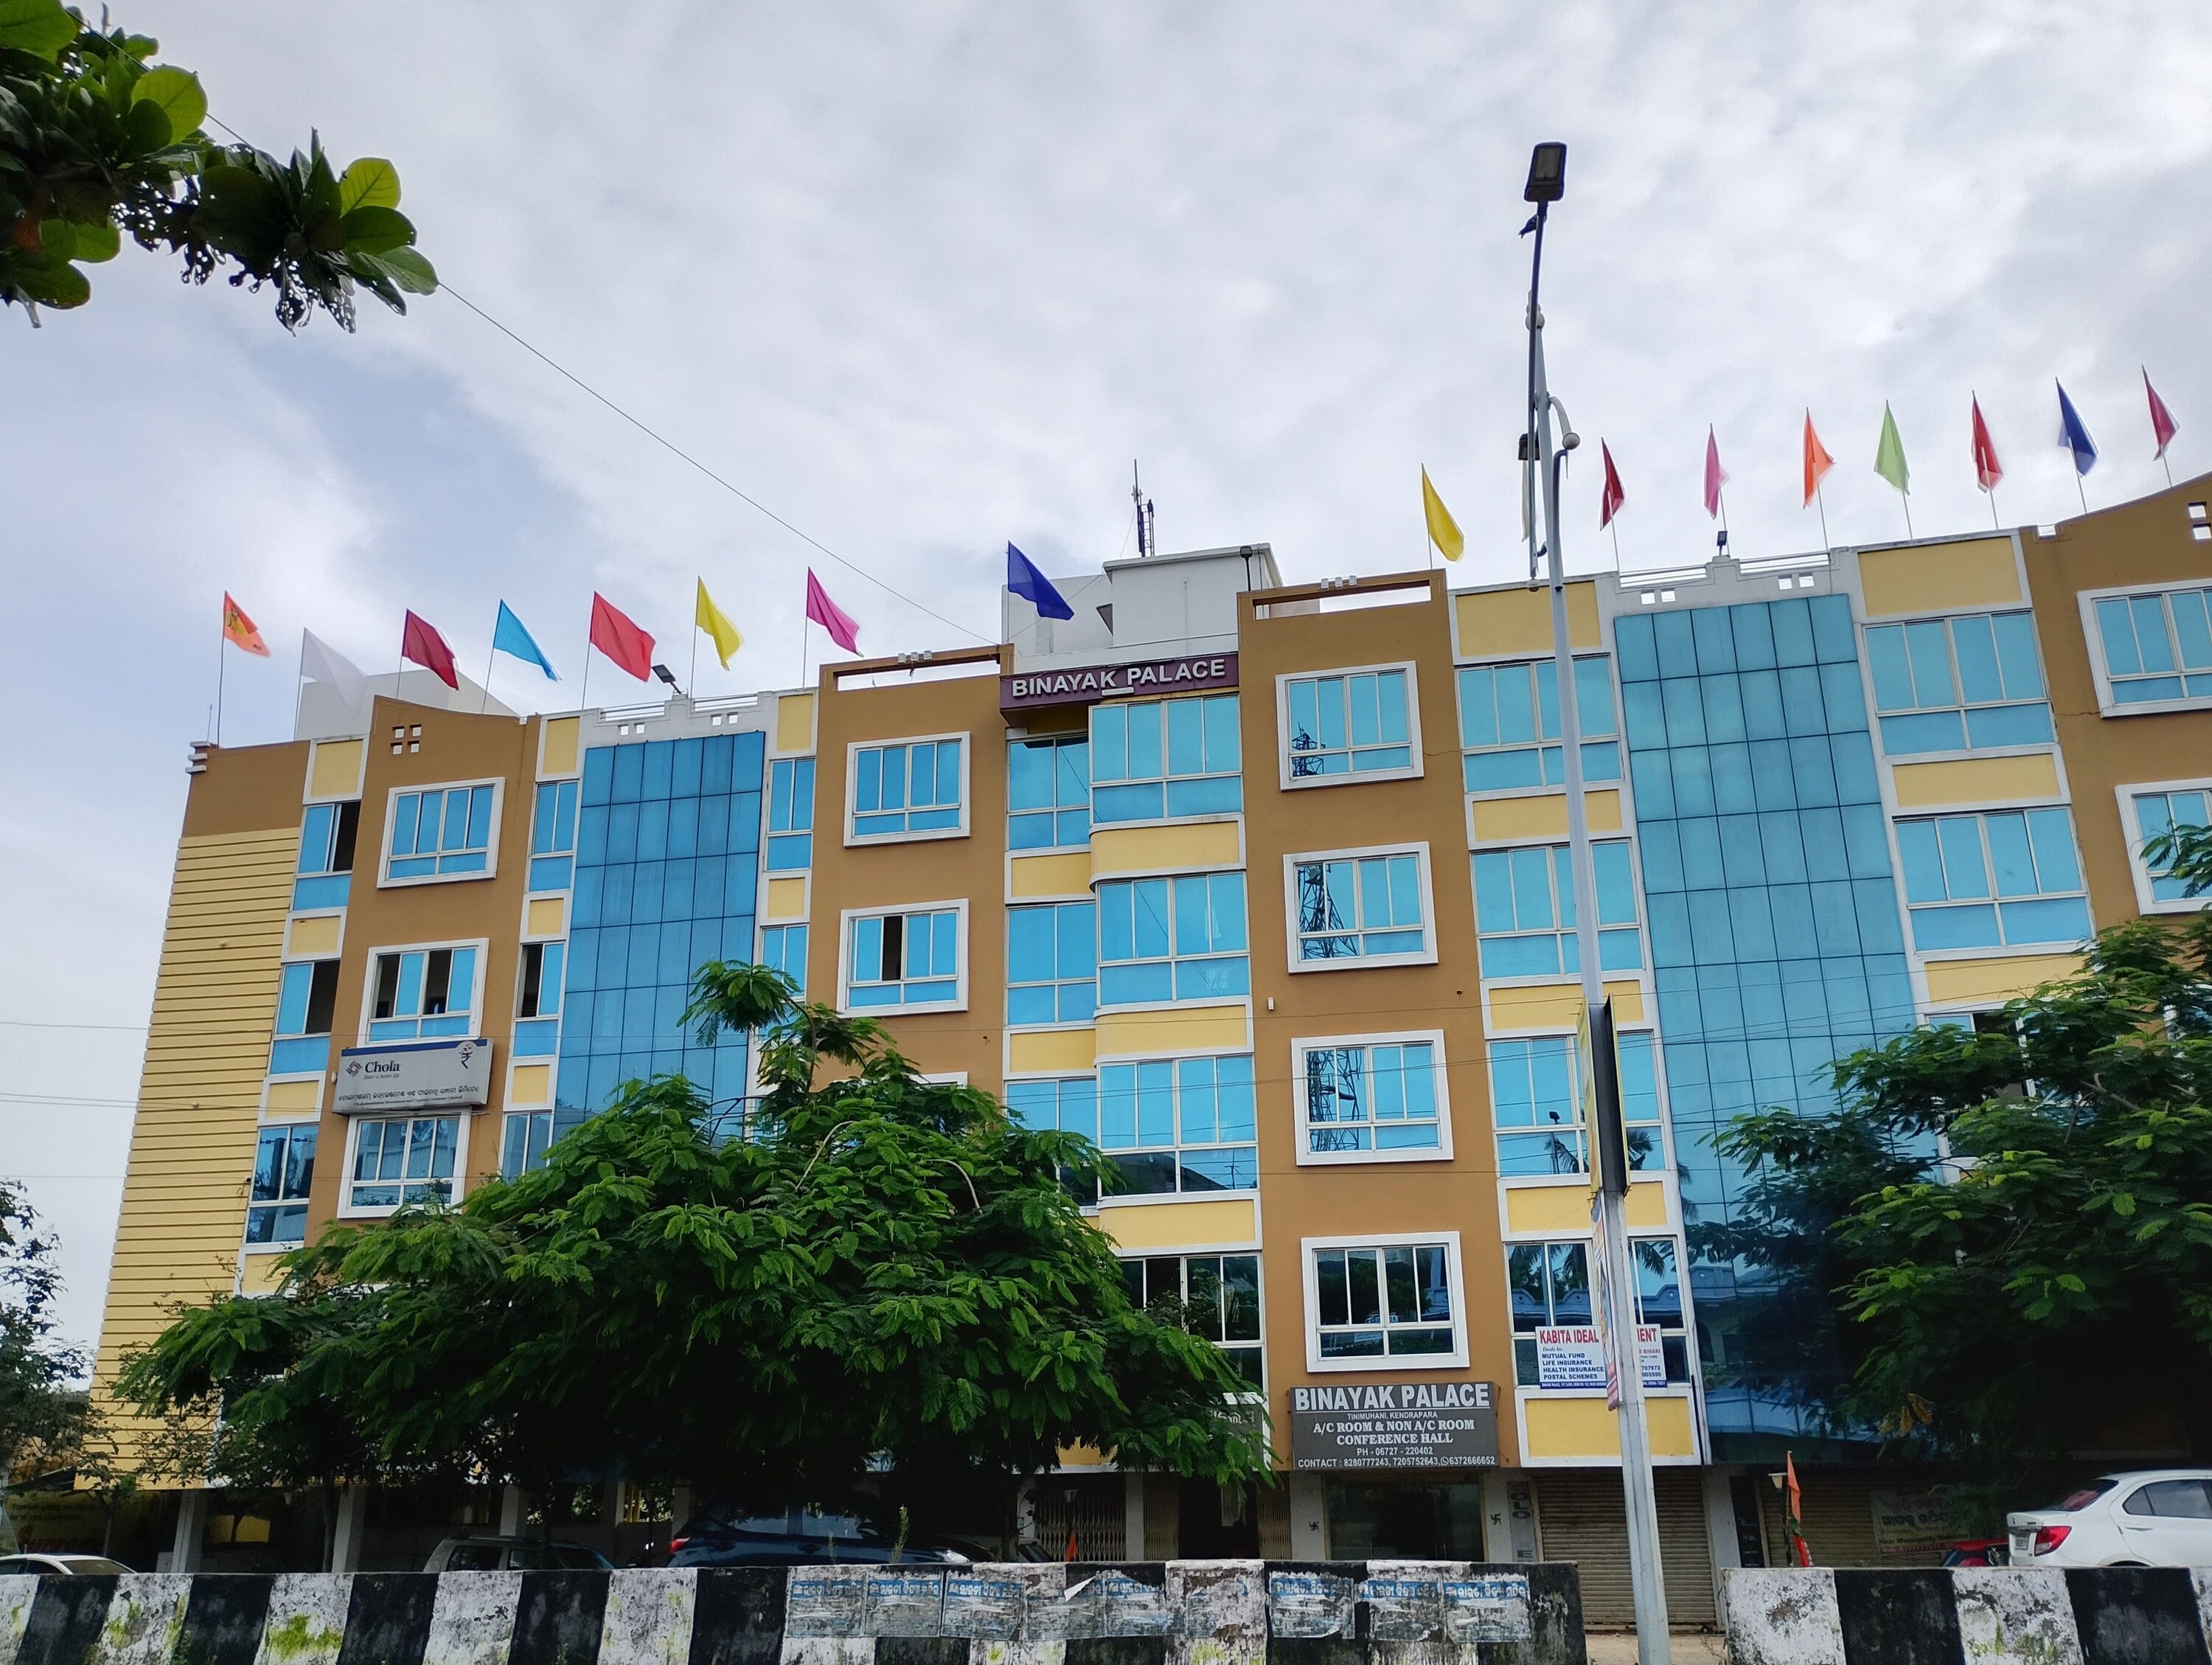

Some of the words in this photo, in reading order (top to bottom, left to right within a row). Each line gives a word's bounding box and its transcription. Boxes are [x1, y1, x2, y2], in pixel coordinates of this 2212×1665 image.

[1012, 670, 1117, 698] BINAYAK
[1127, 658, 1226, 686] PALACE
[364, 1060, 400, 1073] Chola
[1540, 1329, 1572, 1344] KABITA
[1573, 1329, 1599, 1344] IDEAL
[1295, 1385, 1396, 1411] BINAYAK
[1401, 1383, 1490, 1408] PALACE
[1347, 1412, 1388, 1420] TINIMUHANI,
[1389, 1411, 1438, 1419] KENDRAPARA
[1313, 1422, 1335, 1436] A/C
[1337, 1420, 1372, 1433] ROOM
[1374, 1420, 1385, 1432] &
[1386, 1420, 1413, 1432] NON
[1414, 1419, 1436, 1433] A/C
[1438, 1419, 1475, 1431] ROOM
[1336, 1433, 1419, 1445] CONFERENCE
[1421, 1433, 1454, 1444] HALL
[1357, 1447, 1368, 1456] PH
[1375, 1447, 1398, 1456] 06727
[1405, 1446, 1433, 1456] 220402
[1298, 1459, 1338, 1468] CONTACT
[1343, 1458, 1391, 1467] 8280777243,
